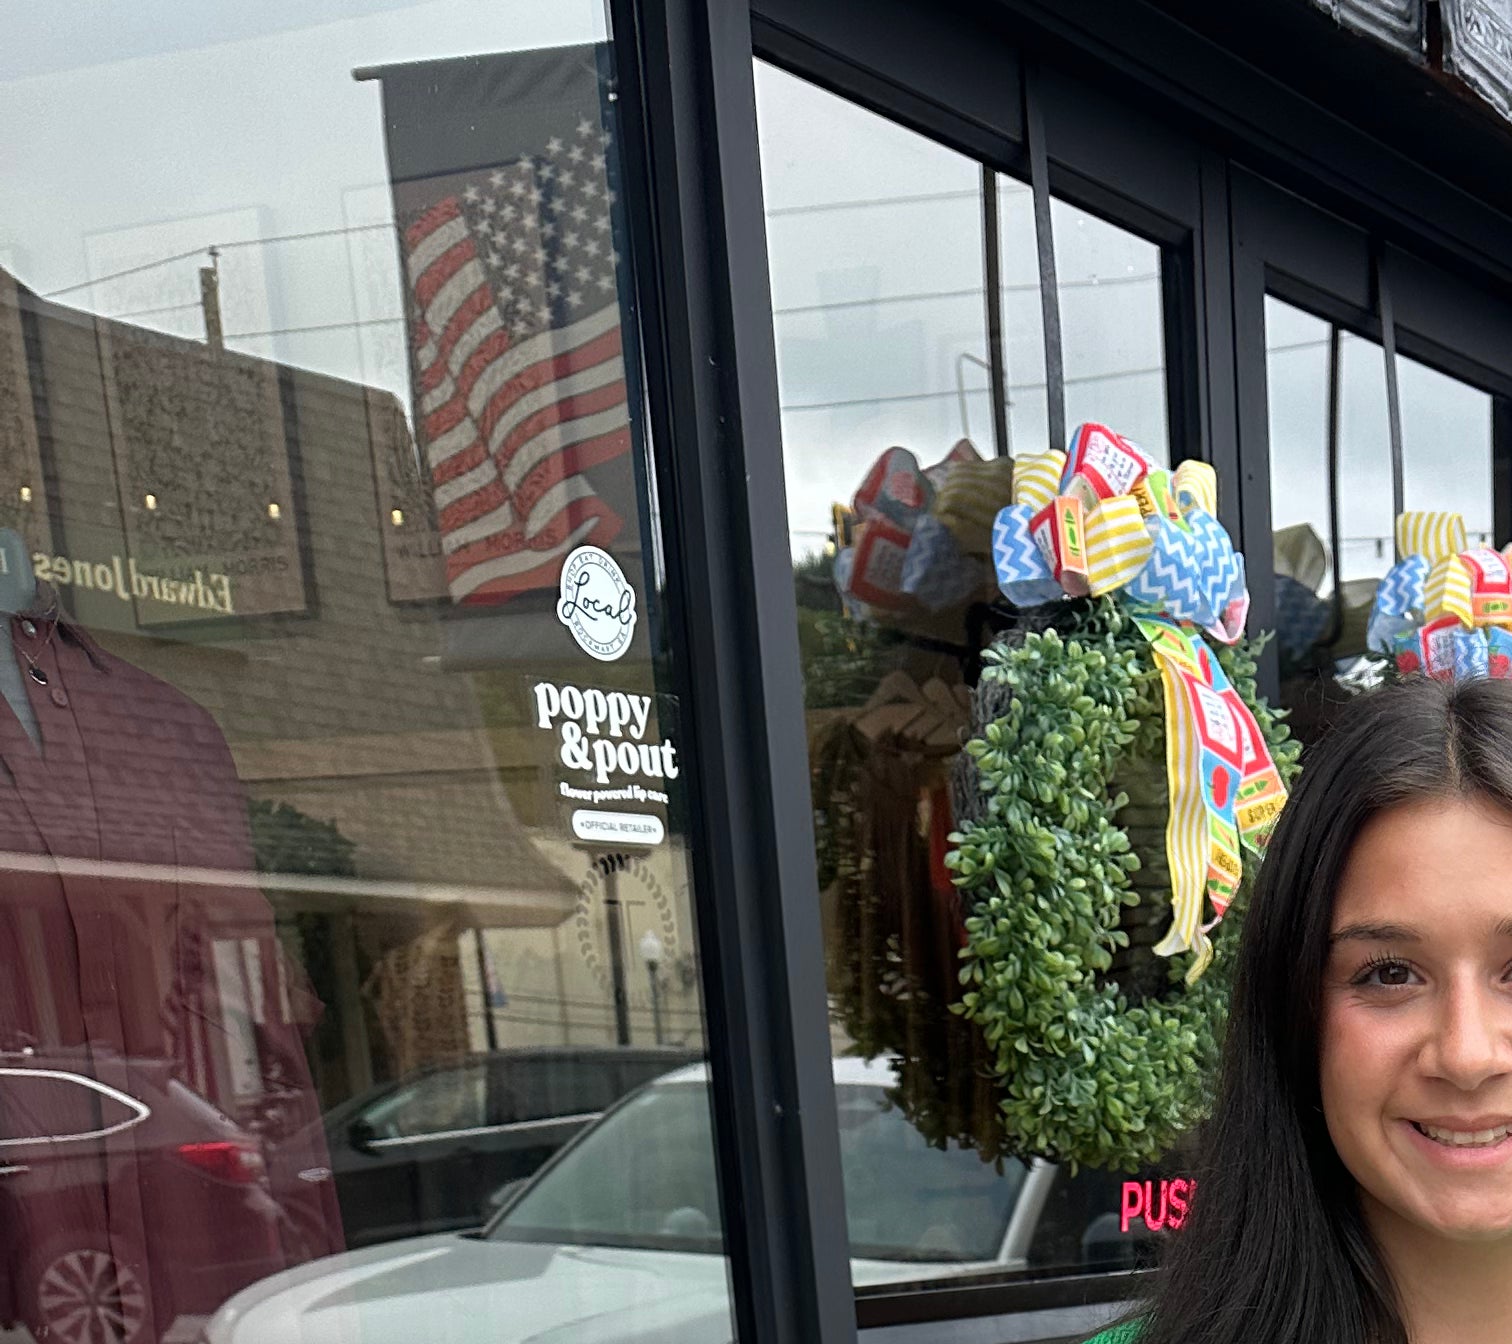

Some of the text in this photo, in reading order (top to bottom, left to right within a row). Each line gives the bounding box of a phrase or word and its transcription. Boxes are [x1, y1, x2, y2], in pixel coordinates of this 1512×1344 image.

[562, 571, 632, 625] Local
[534, 682, 651, 740] poppy
[1121, 1178, 1197, 1232] PUS
